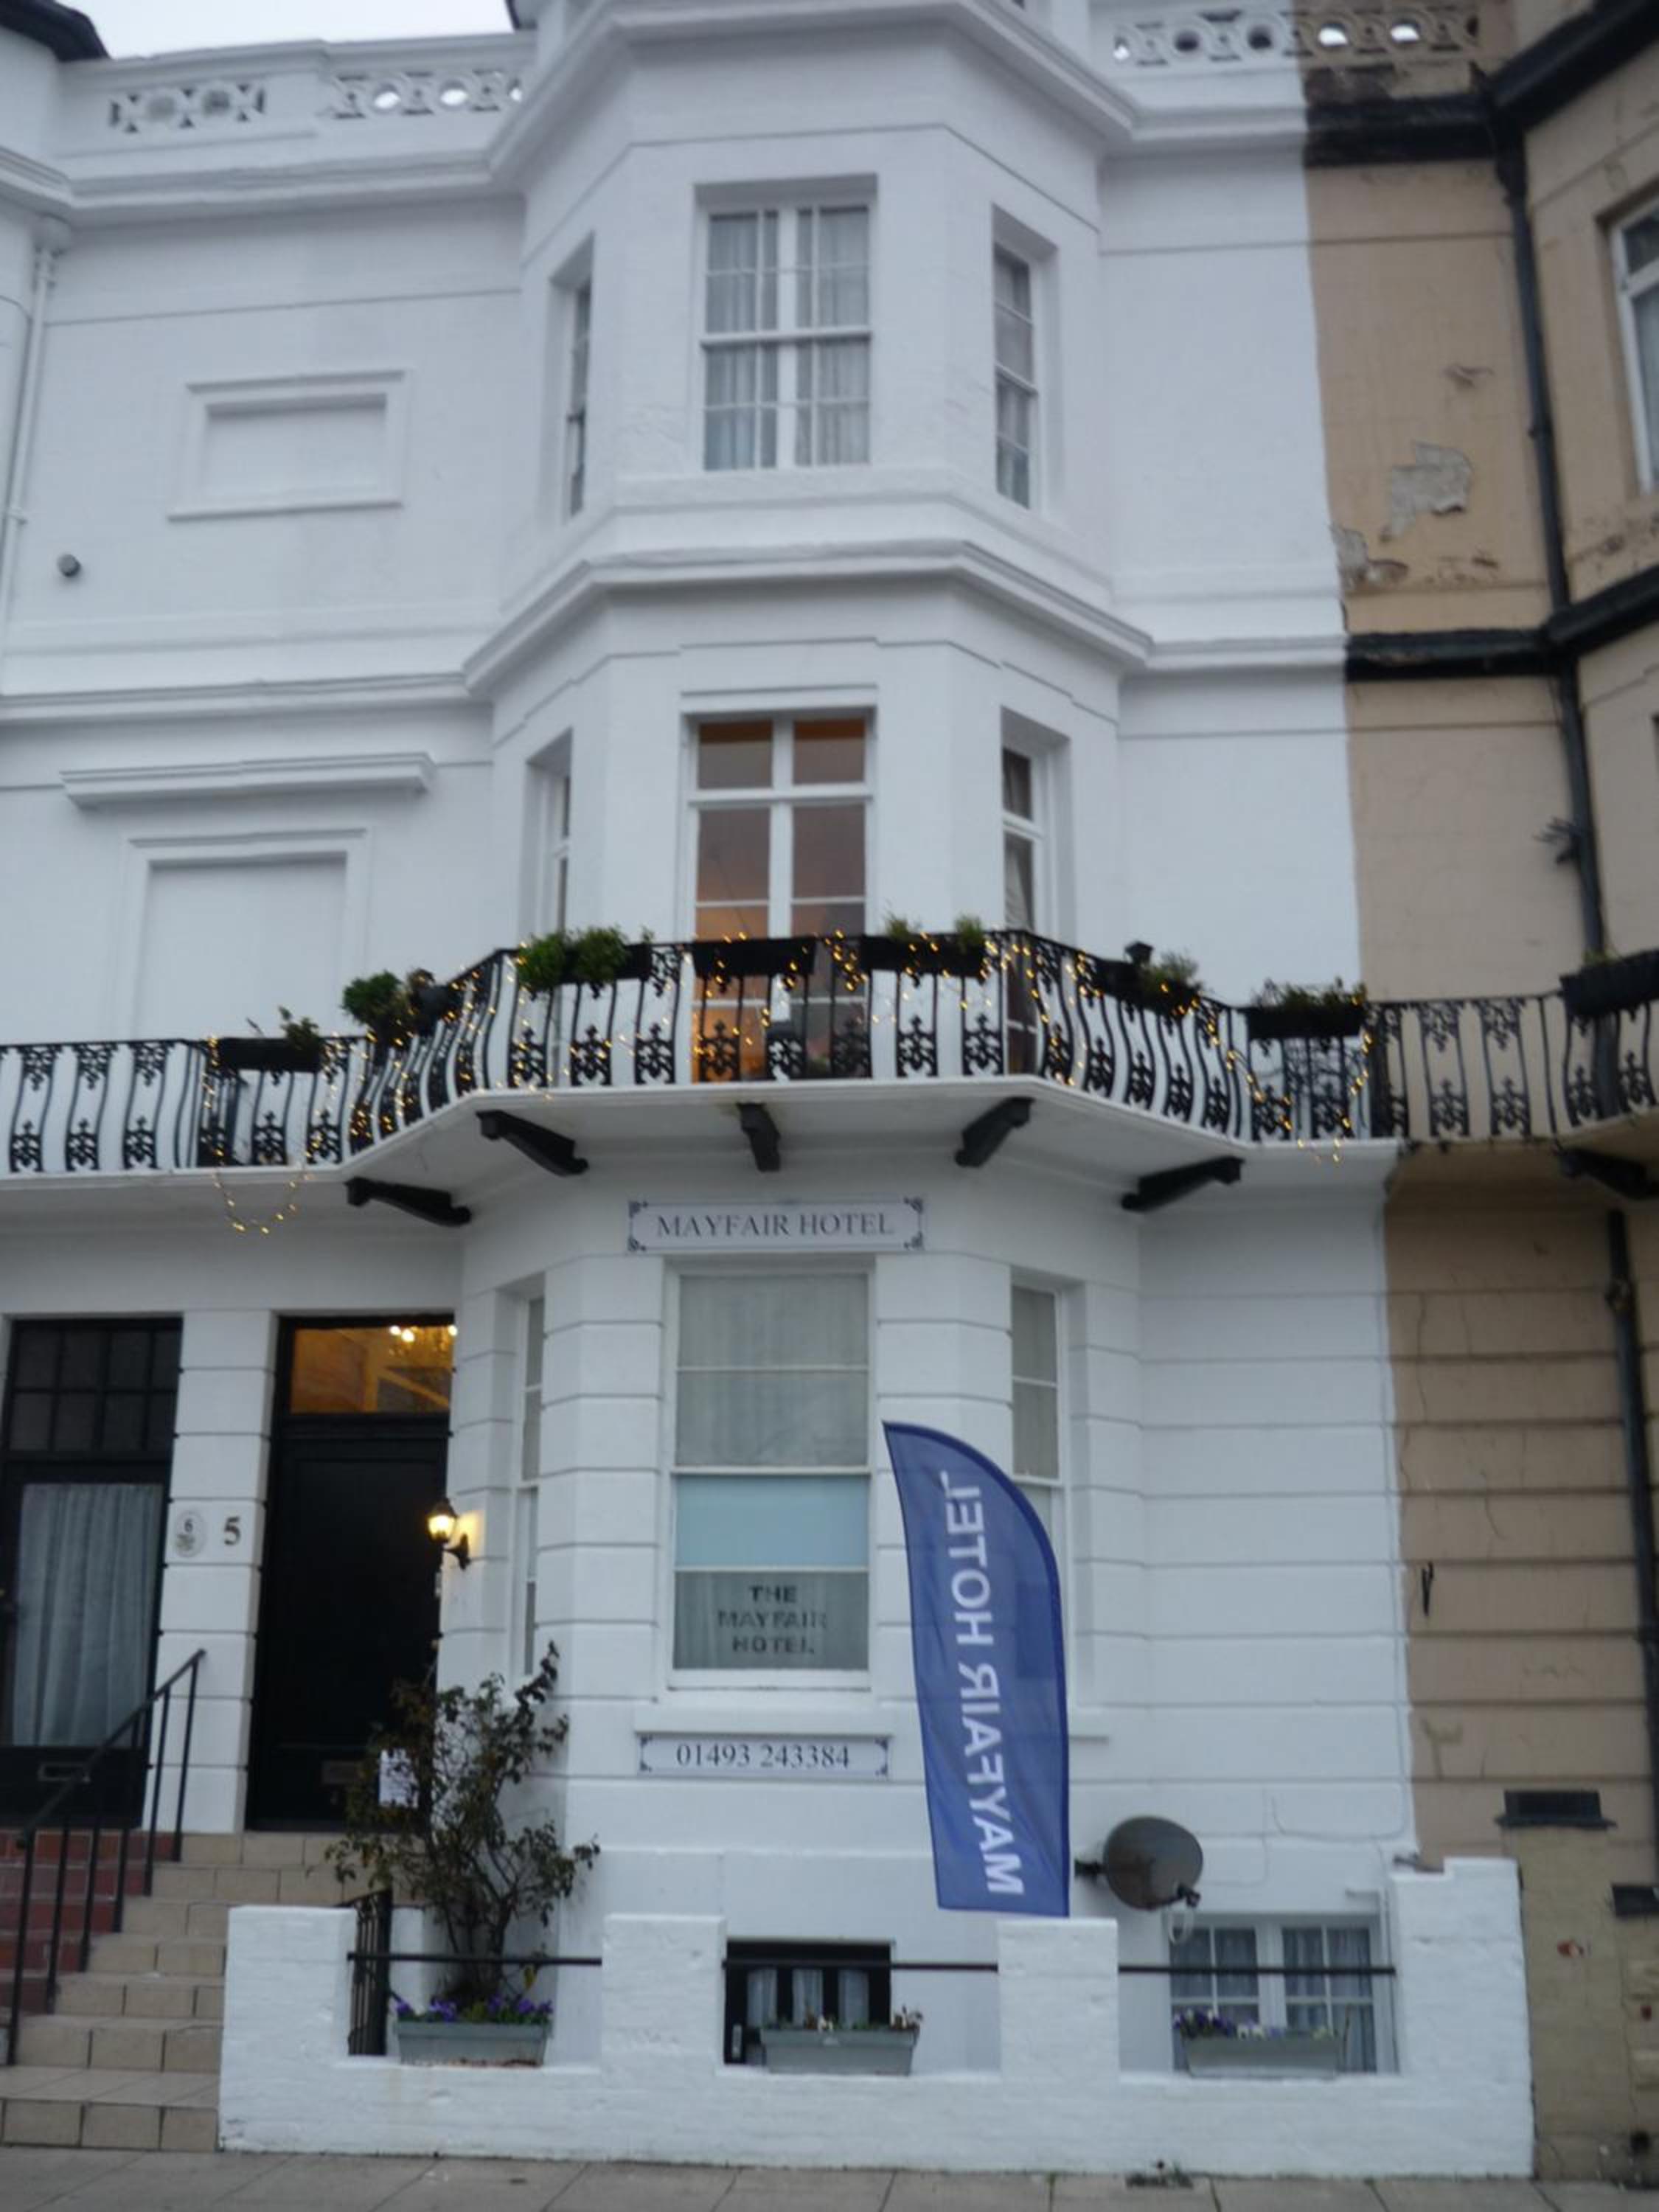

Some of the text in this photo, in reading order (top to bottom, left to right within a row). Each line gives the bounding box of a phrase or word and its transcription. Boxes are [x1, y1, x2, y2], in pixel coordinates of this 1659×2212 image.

[656, 1211, 895, 1237] MAYFAIR HOTEL
[224, 1515, 241, 1545] 5
[749, 1585, 799, 1603] THE
[717, 1610, 827, 1629] MAYFAIR
[731, 1636, 815, 1654] HOTEL
[676, 1743, 849, 1769] 01493 243384
